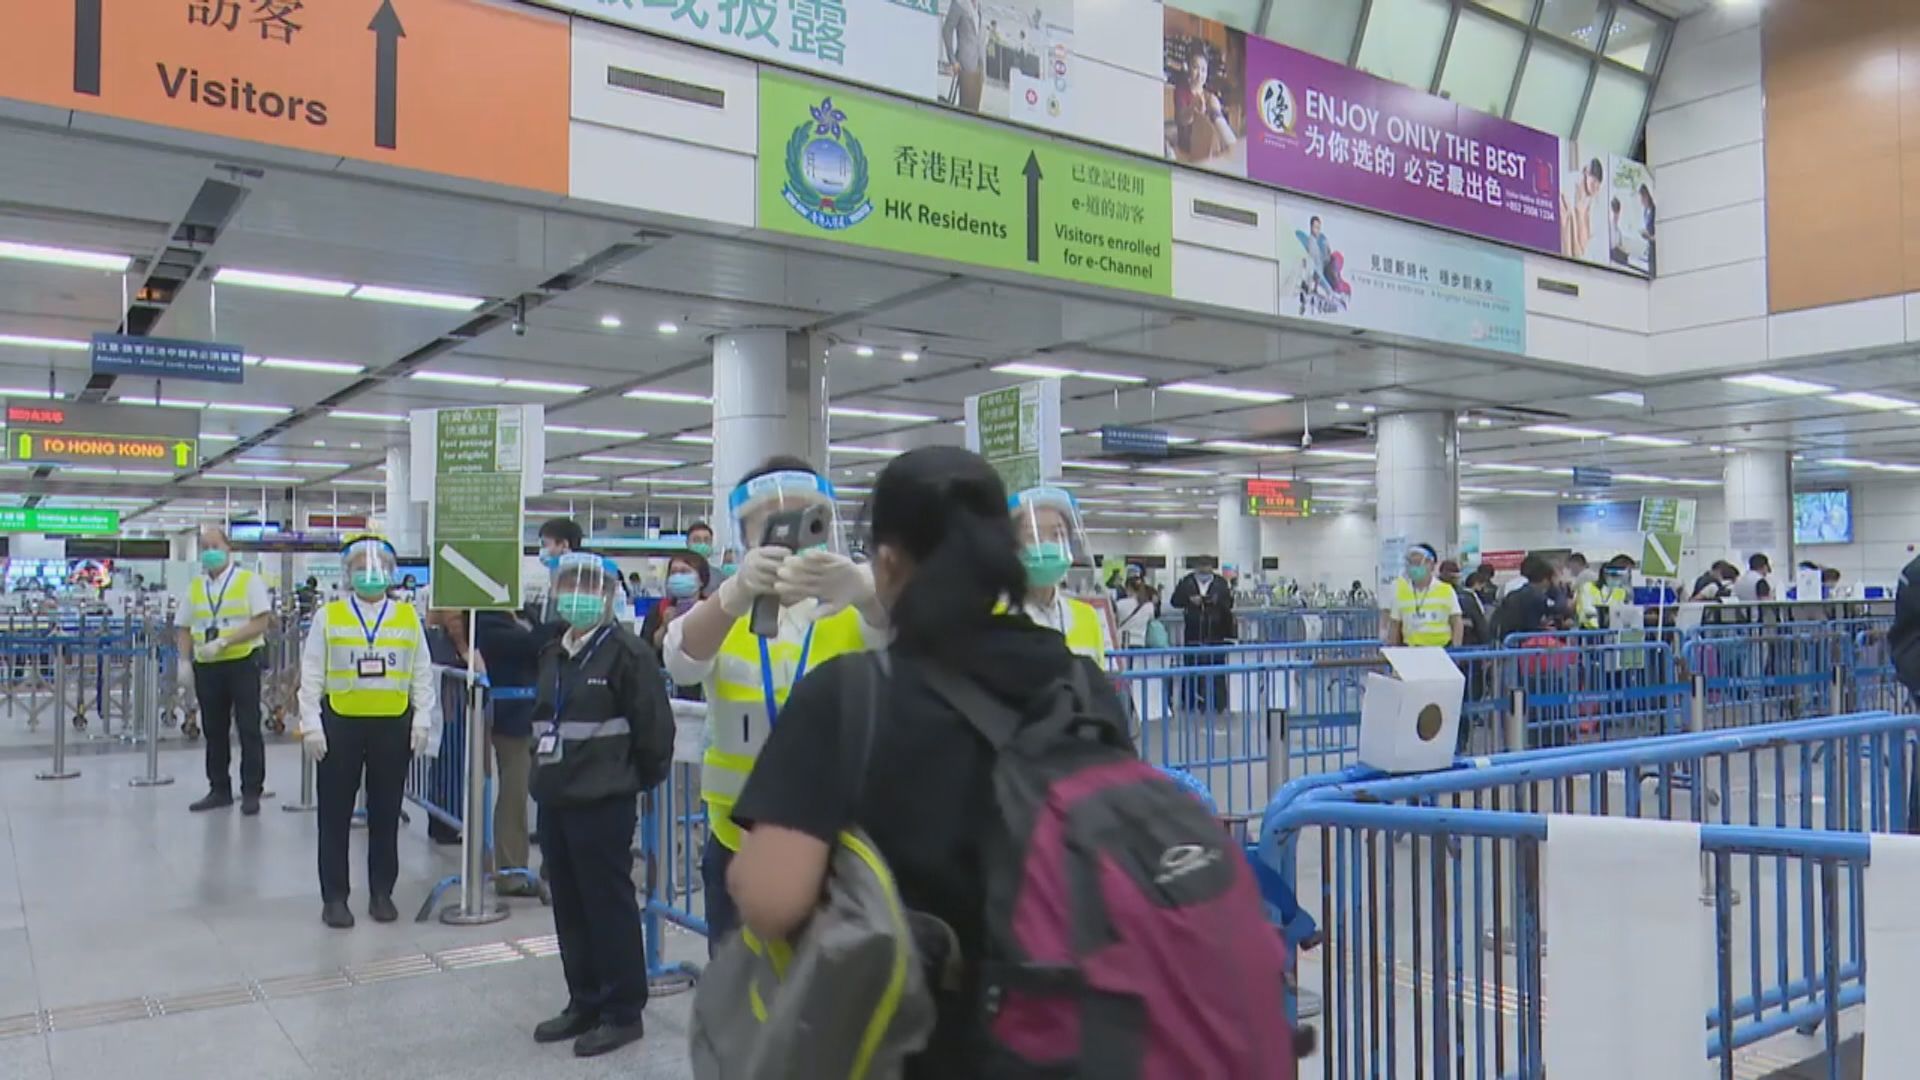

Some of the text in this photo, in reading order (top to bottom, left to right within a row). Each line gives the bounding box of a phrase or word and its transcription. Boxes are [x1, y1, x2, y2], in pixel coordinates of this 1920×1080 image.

[156, 62, 328, 126] Visitors
[1305, 89, 1527, 180] ENJOY ONLY THE BEST
[894, 145, 1001, 196] 香港居民
[1305, 125, 1503, 207] 为你选的 必定最出色
[885, 198, 913, 222] HK
[918, 204, 1008, 239] Residents
[1055, 224, 1161, 257] Visitors enrolled
[1064, 248, 1153, 279] for e-Channel
[43, 438, 166, 458] TO HONG KONG
